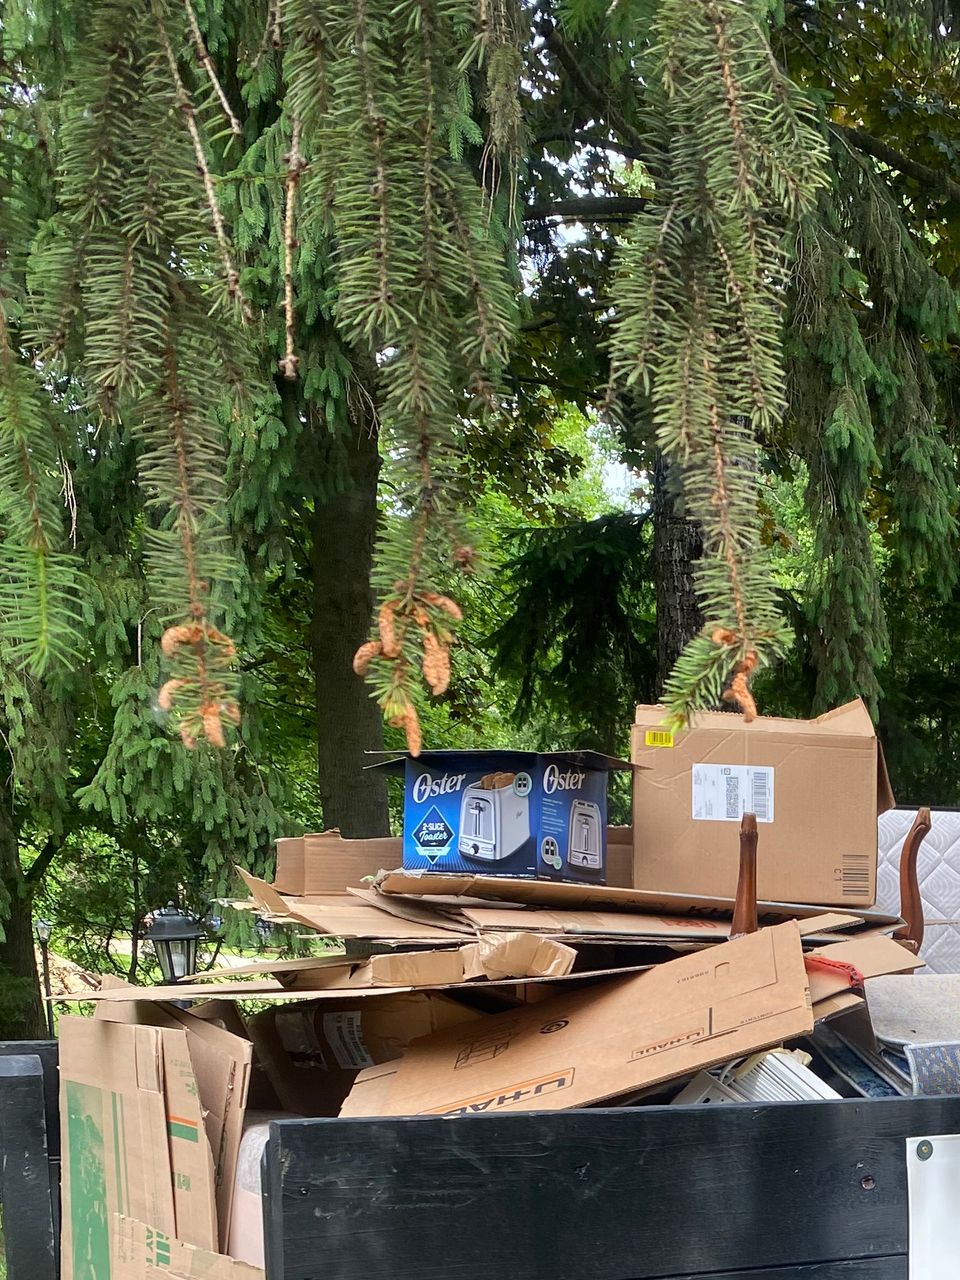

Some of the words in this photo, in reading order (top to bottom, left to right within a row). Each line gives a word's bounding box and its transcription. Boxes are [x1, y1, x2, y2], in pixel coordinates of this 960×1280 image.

[412, 773, 467, 804] Oster
[543, 764, 585, 794] Oster
[419, 830, 449, 843] Toaster
[422, 822, 445, 831] 2-SLICE
[635, 1032, 700, 1055] U-HAUL
